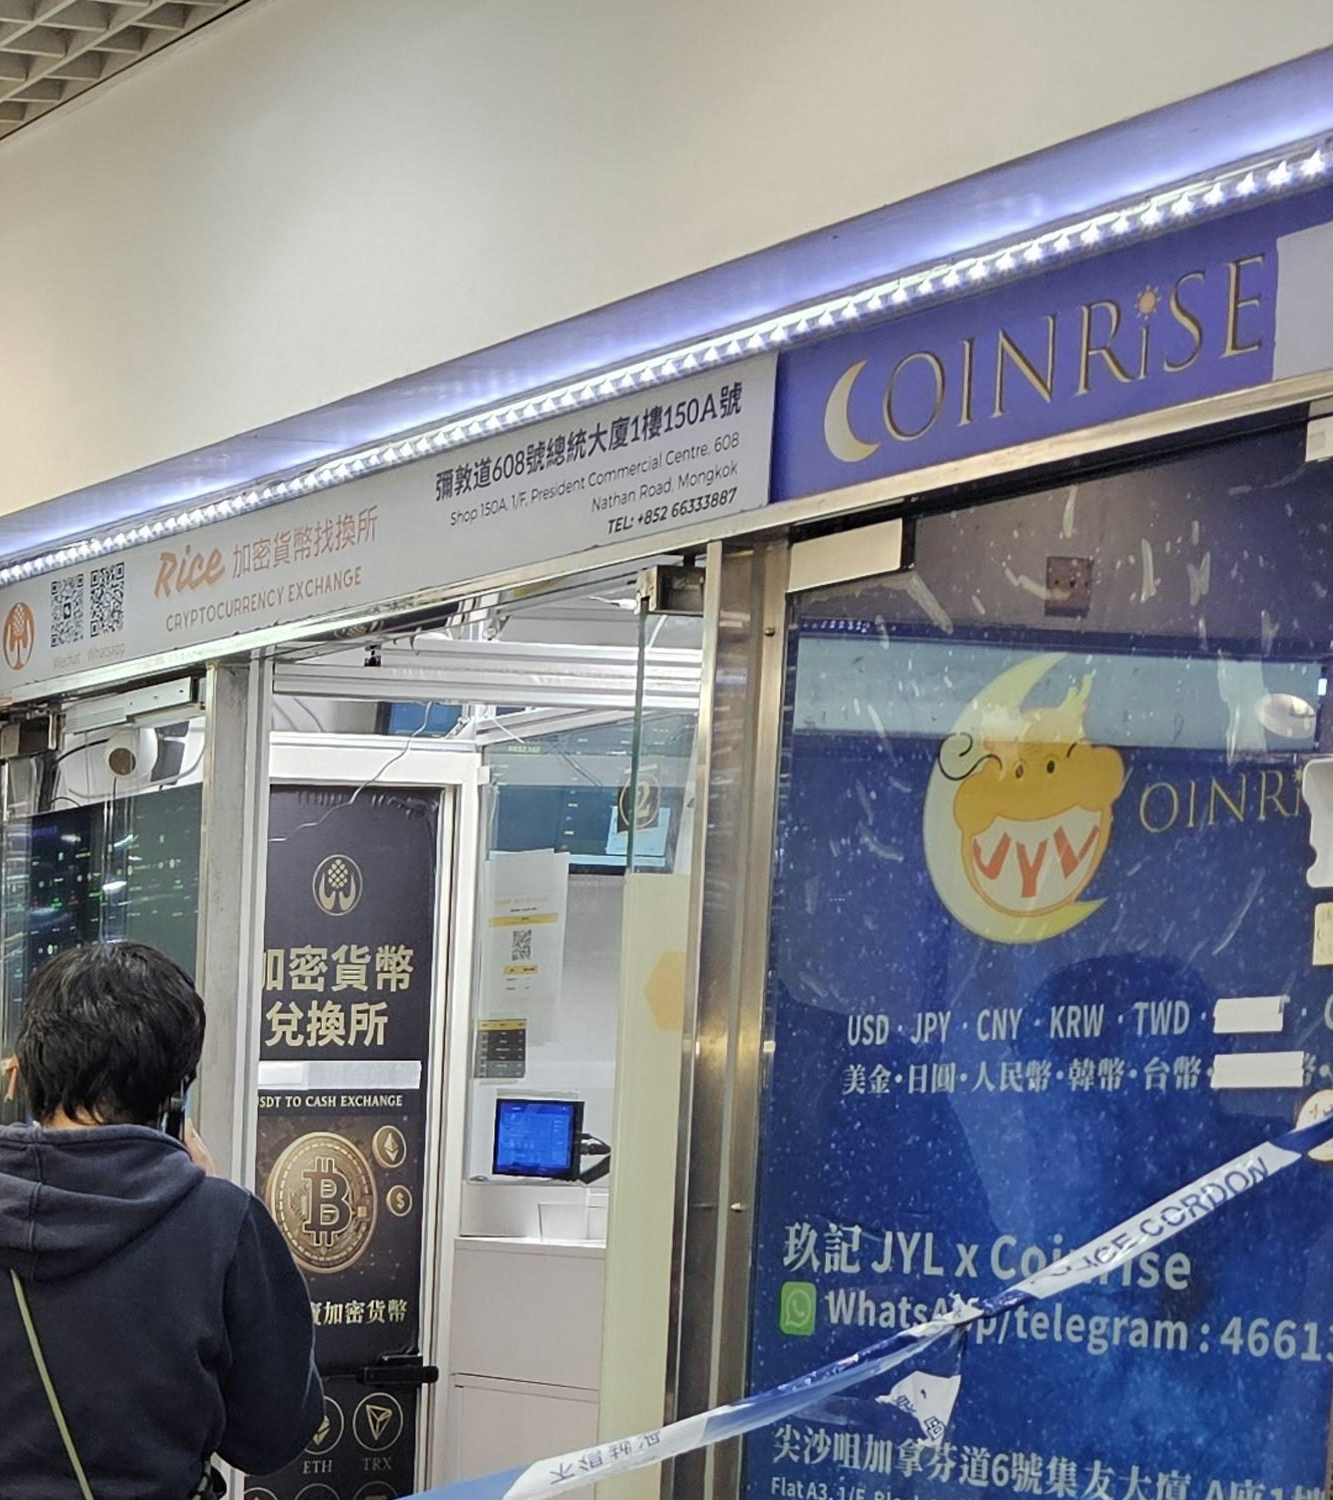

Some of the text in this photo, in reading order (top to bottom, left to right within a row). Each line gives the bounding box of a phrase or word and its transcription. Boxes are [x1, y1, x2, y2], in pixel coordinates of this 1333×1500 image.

[450, 505, 478, 527] Shop
[531, 476, 585, 505] President
[588, 454, 663, 488] Commercial
[666, 441, 712, 466] Centre,
[714, 432, 740, 452] 608
[591, 461, 739, 513] Nathan Road, Mongkok
[607, 487, 738, 535] TEL: +852 66333887
[232, 505, 378, 579] 加密貨幣找換所
[153, 544, 226, 599] Rice
[165, 566, 362, 633] CRYPTOCURRENCY EXCHANGE
[846, 999, 1190, 1046] USD JPY CNY KRW TWD
[258, 1094, 403, 1109] SDT TO CASH EXCHANGE
[1139, 1156, 1270, 1238] CORDON
[783, 1221, 863, 1275] 玖記
[871, 1230, 944, 1276] JYL
[1219, 1315, 1333, 1364] 4661
[302, 1456, 393, 1475] ETH TRX
[770, 1476, 804, 1499] Flat
